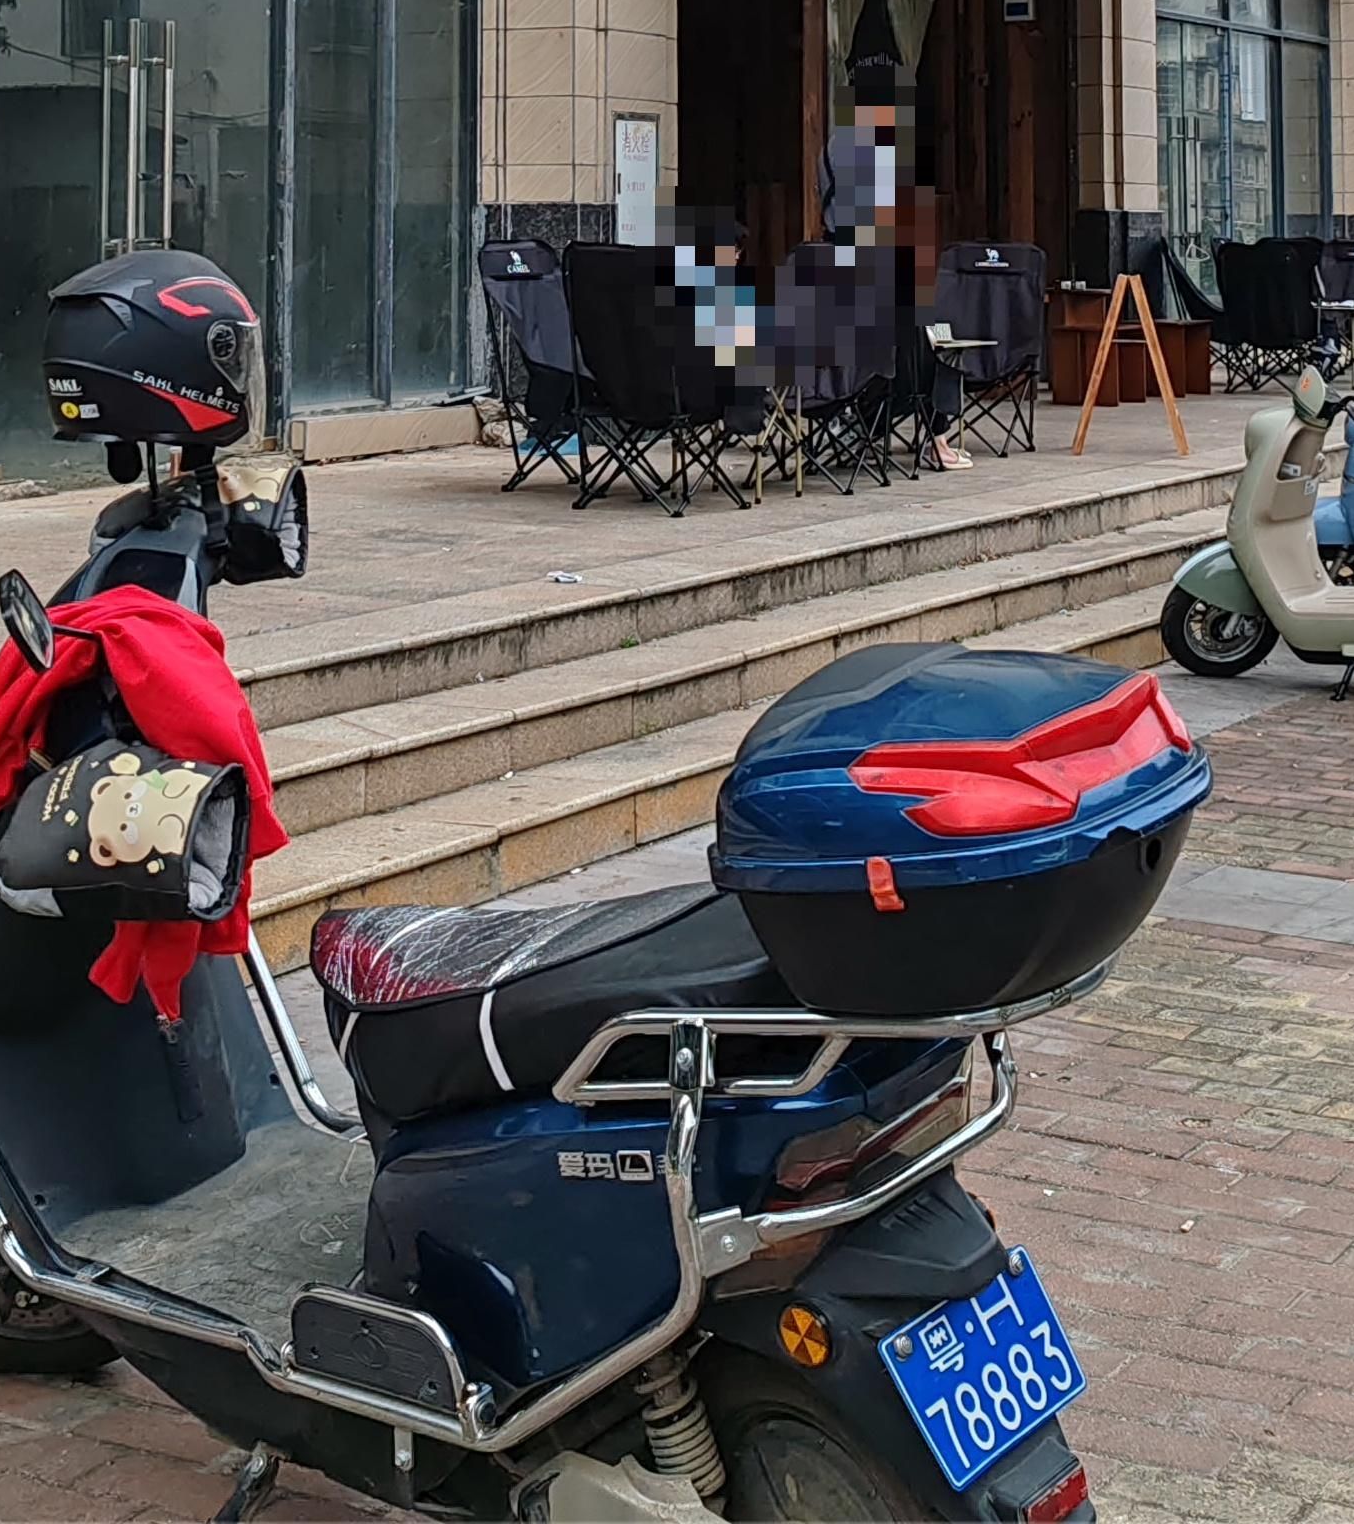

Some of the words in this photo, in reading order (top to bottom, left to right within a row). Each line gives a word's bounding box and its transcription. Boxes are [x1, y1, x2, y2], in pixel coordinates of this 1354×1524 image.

[48, 378, 83, 393] SAKL
[132, 370, 176, 393] SAKL
[180, 385, 241, 414] HELMETS
[924, 1320, 1073, 1470] 78883
